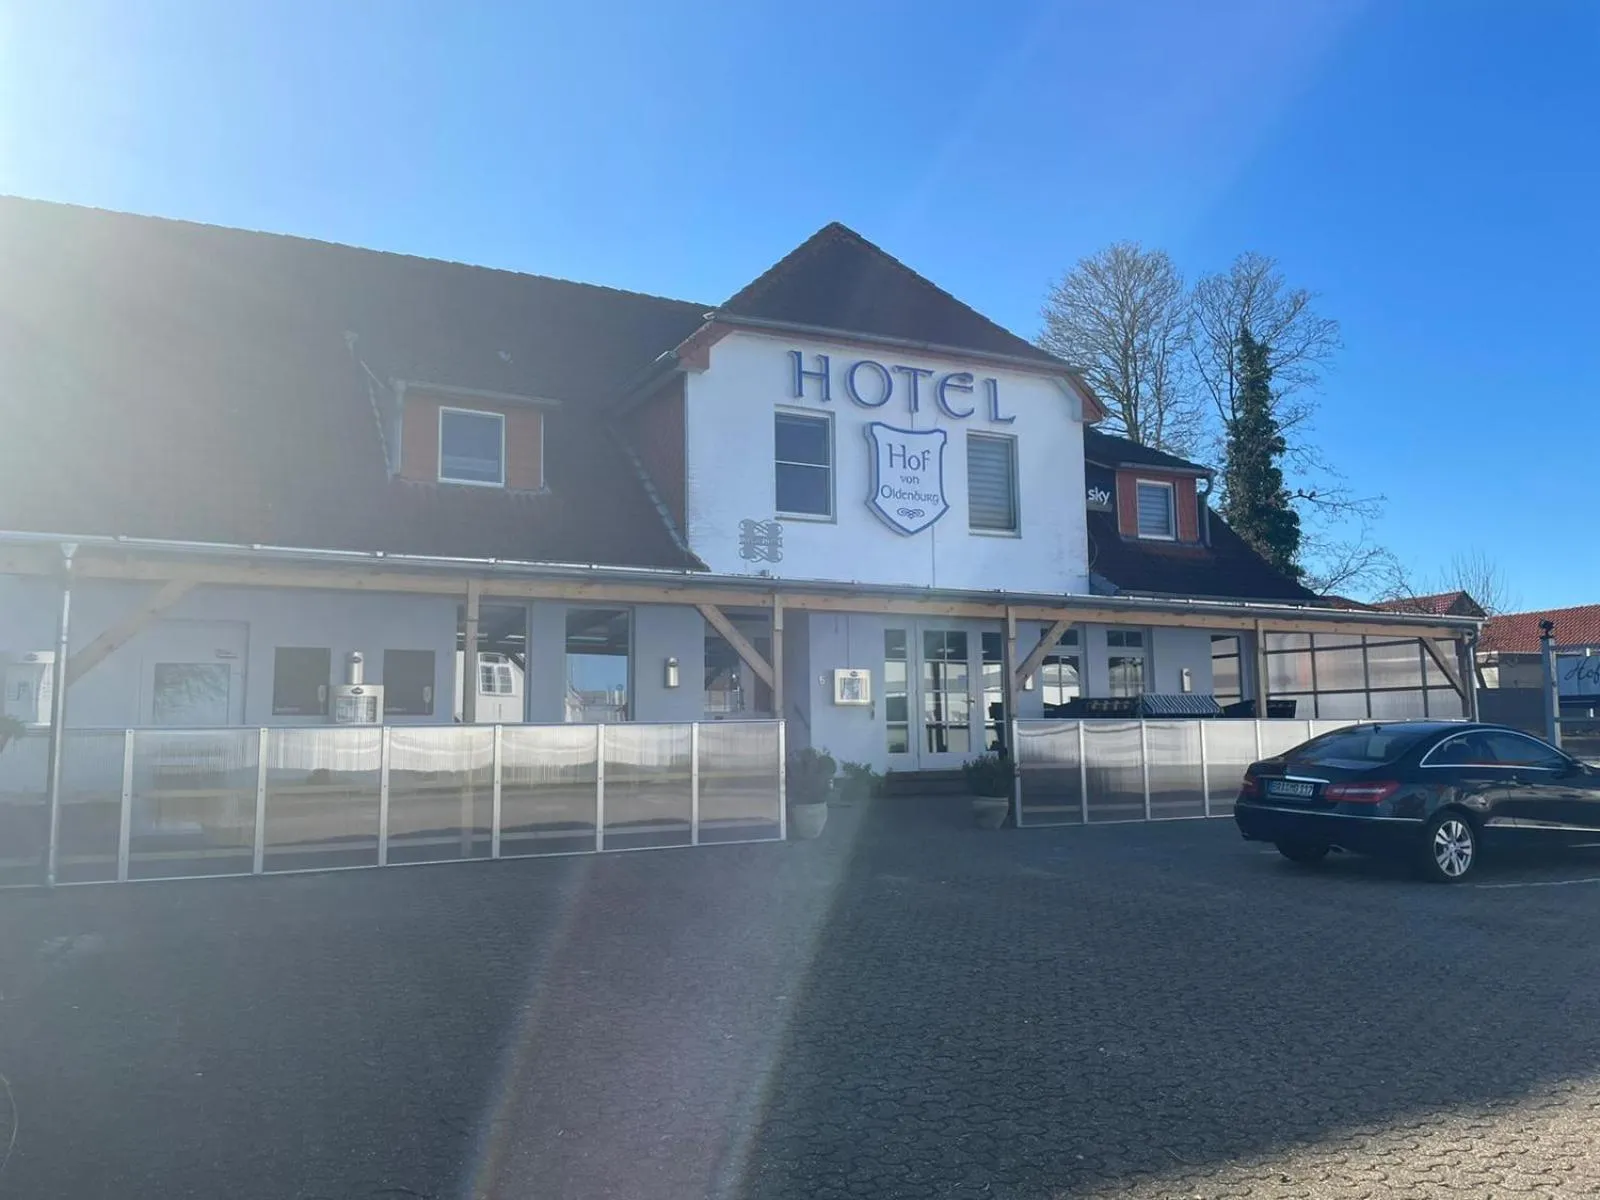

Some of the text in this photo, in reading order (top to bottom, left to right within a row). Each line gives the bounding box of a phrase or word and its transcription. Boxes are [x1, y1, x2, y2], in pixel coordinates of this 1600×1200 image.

[787, 350, 1016, 424] HOTEL
[887, 443, 931, 471] Hof
[899, 474, 920, 485] von
[880, 484, 940, 506] Oldenburg
[1087, 486, 1110, 506] sky
